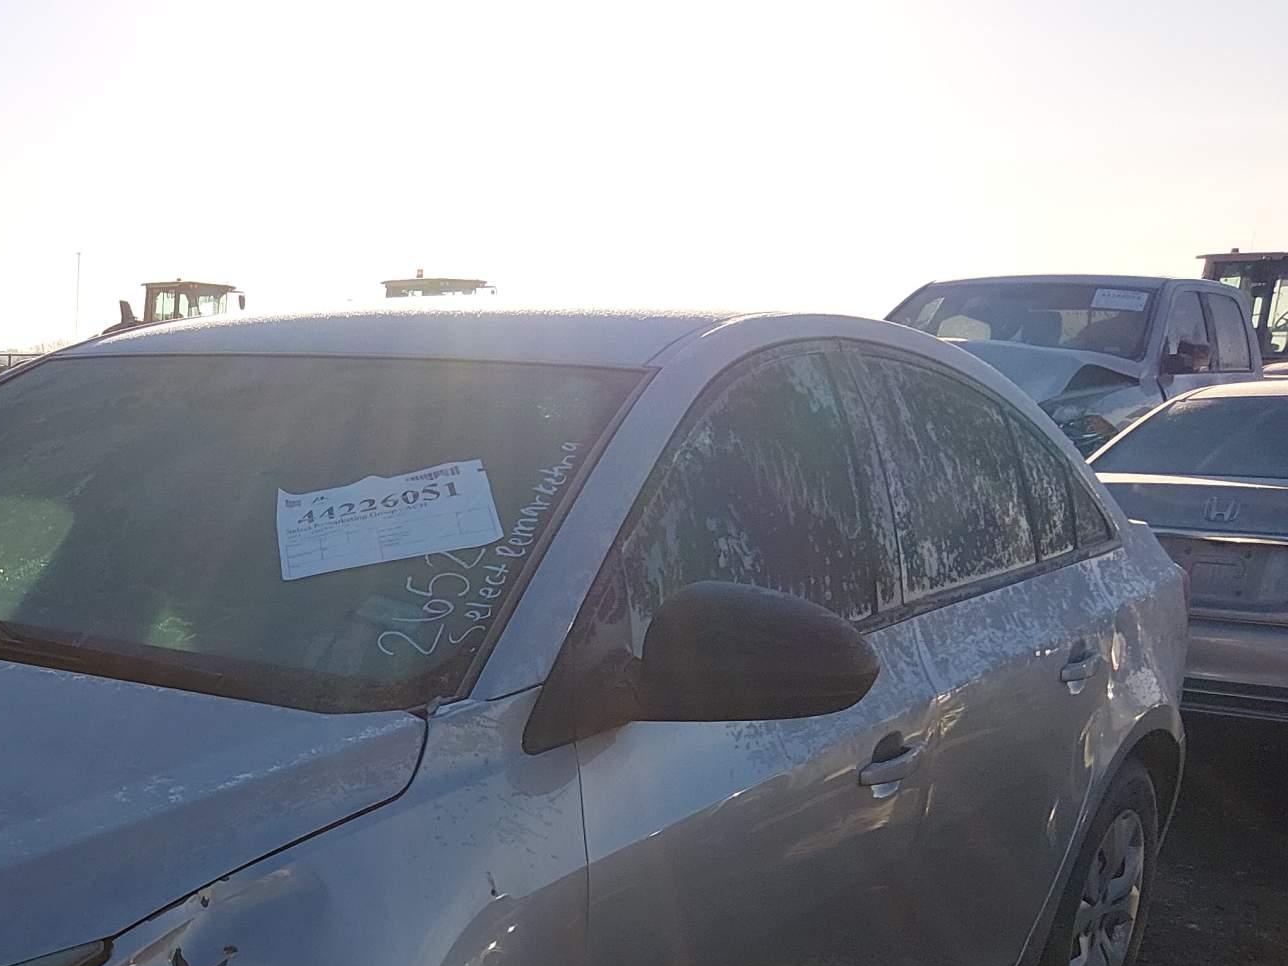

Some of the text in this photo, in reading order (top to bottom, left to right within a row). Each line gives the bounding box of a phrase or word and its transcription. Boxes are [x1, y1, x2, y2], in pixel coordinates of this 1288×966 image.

[297, 481, 461, 524] 44226051
[377, 547, 486, 656] 2652
[448, 563, 509, 644] Select
